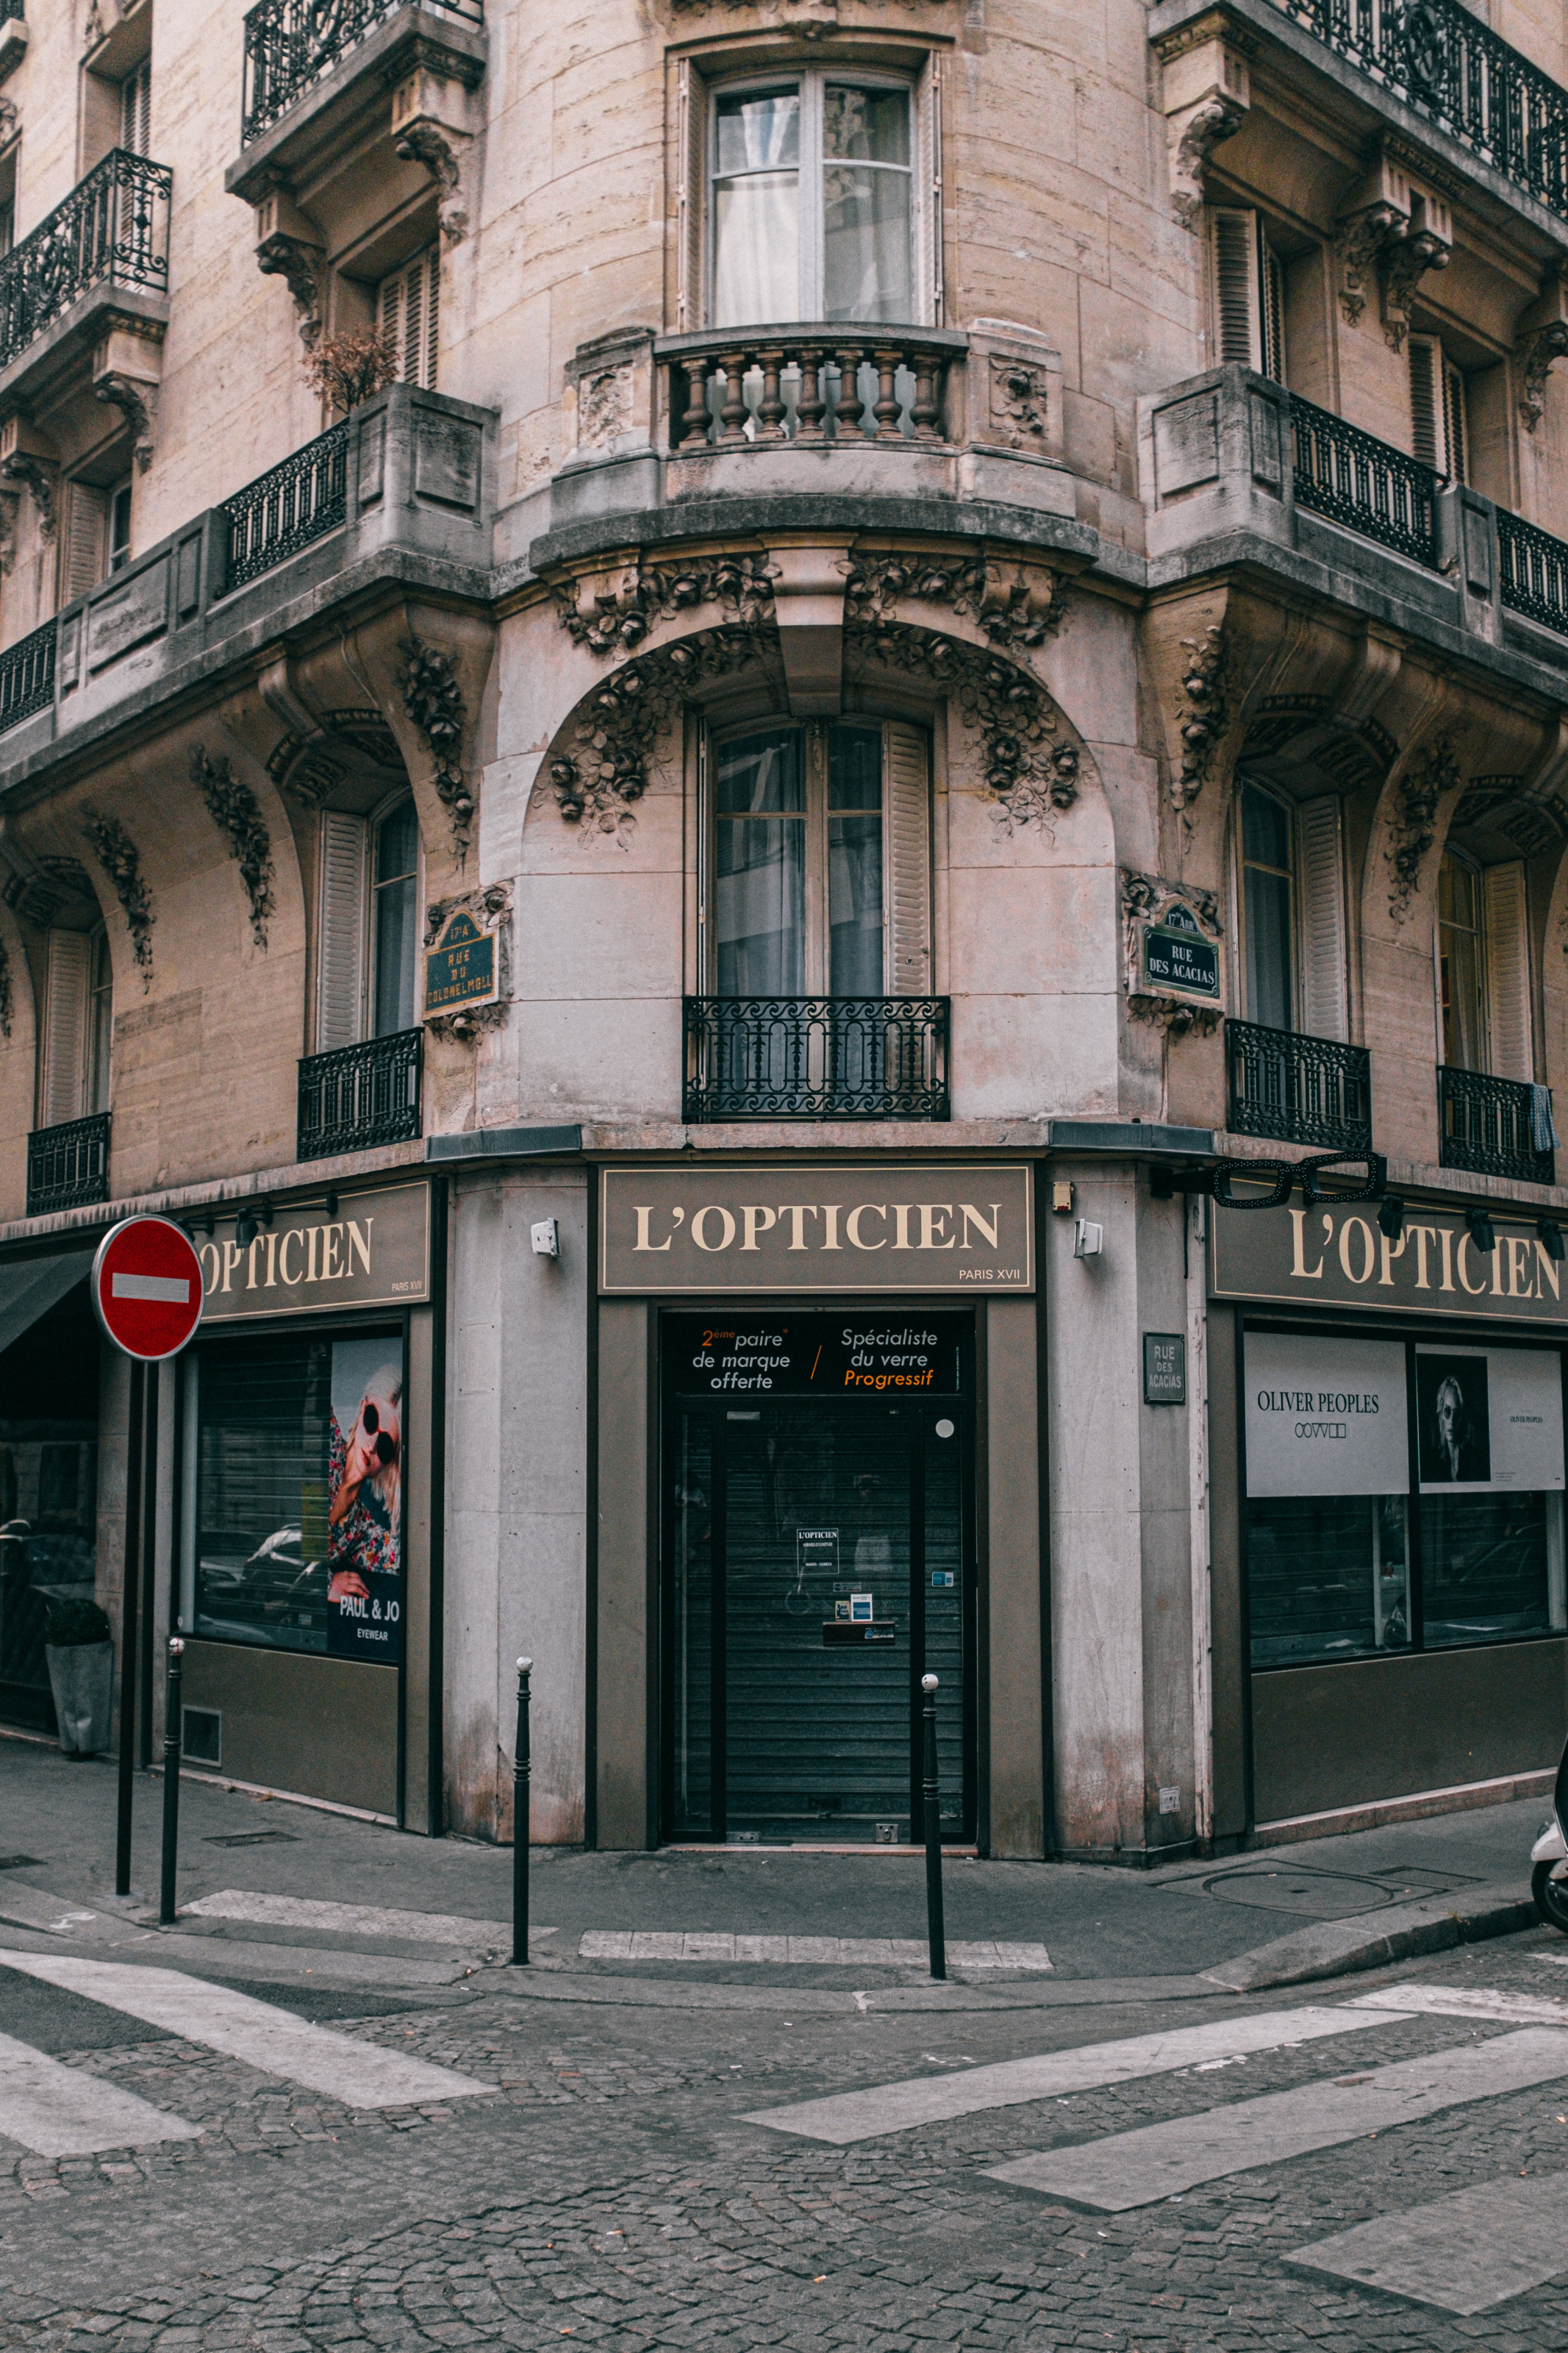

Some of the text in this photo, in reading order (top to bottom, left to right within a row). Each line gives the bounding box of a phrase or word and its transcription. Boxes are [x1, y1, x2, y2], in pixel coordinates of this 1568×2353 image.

[448, 949, 470, 967] RUE
[1172, 945, 1192, 963] RUE
[451, 966, 466, 981] DU
[1149, 958, 1215, 985] DES ACACIAS
[428, 974, 491, 1004] COLONEL MOLL
[631, 1204, 1002, 1252] L'OPTICIEN
[1288, 1209, 1560, 1301] L'OPTICIEN
[959, 1269, 1020, 1280] PARIS XVII
[392, 1280, 422, 1292] PARIS XVII
[841, 1329, 937, 1349] Spécialiste
[692, 1351, 790, 1372] de marque
[851, 1349, 928, 1367] du verre
[1154, 1345, 1175, 1360] RUE
[1157, 1362, 1173, 1372] DES
[710, 1372, 773, 1389] offerte
[845, 1369, 934, 1390] Progressif
[1149, 1374, 1182, 1388] ACACIAS
[1257, 1390, 1379, 1414] OLIVER PEOPLES
[340, 1596, 400, 1622] PAUL & JO
[357, 1628, 388, 1642] EYEWEAR
